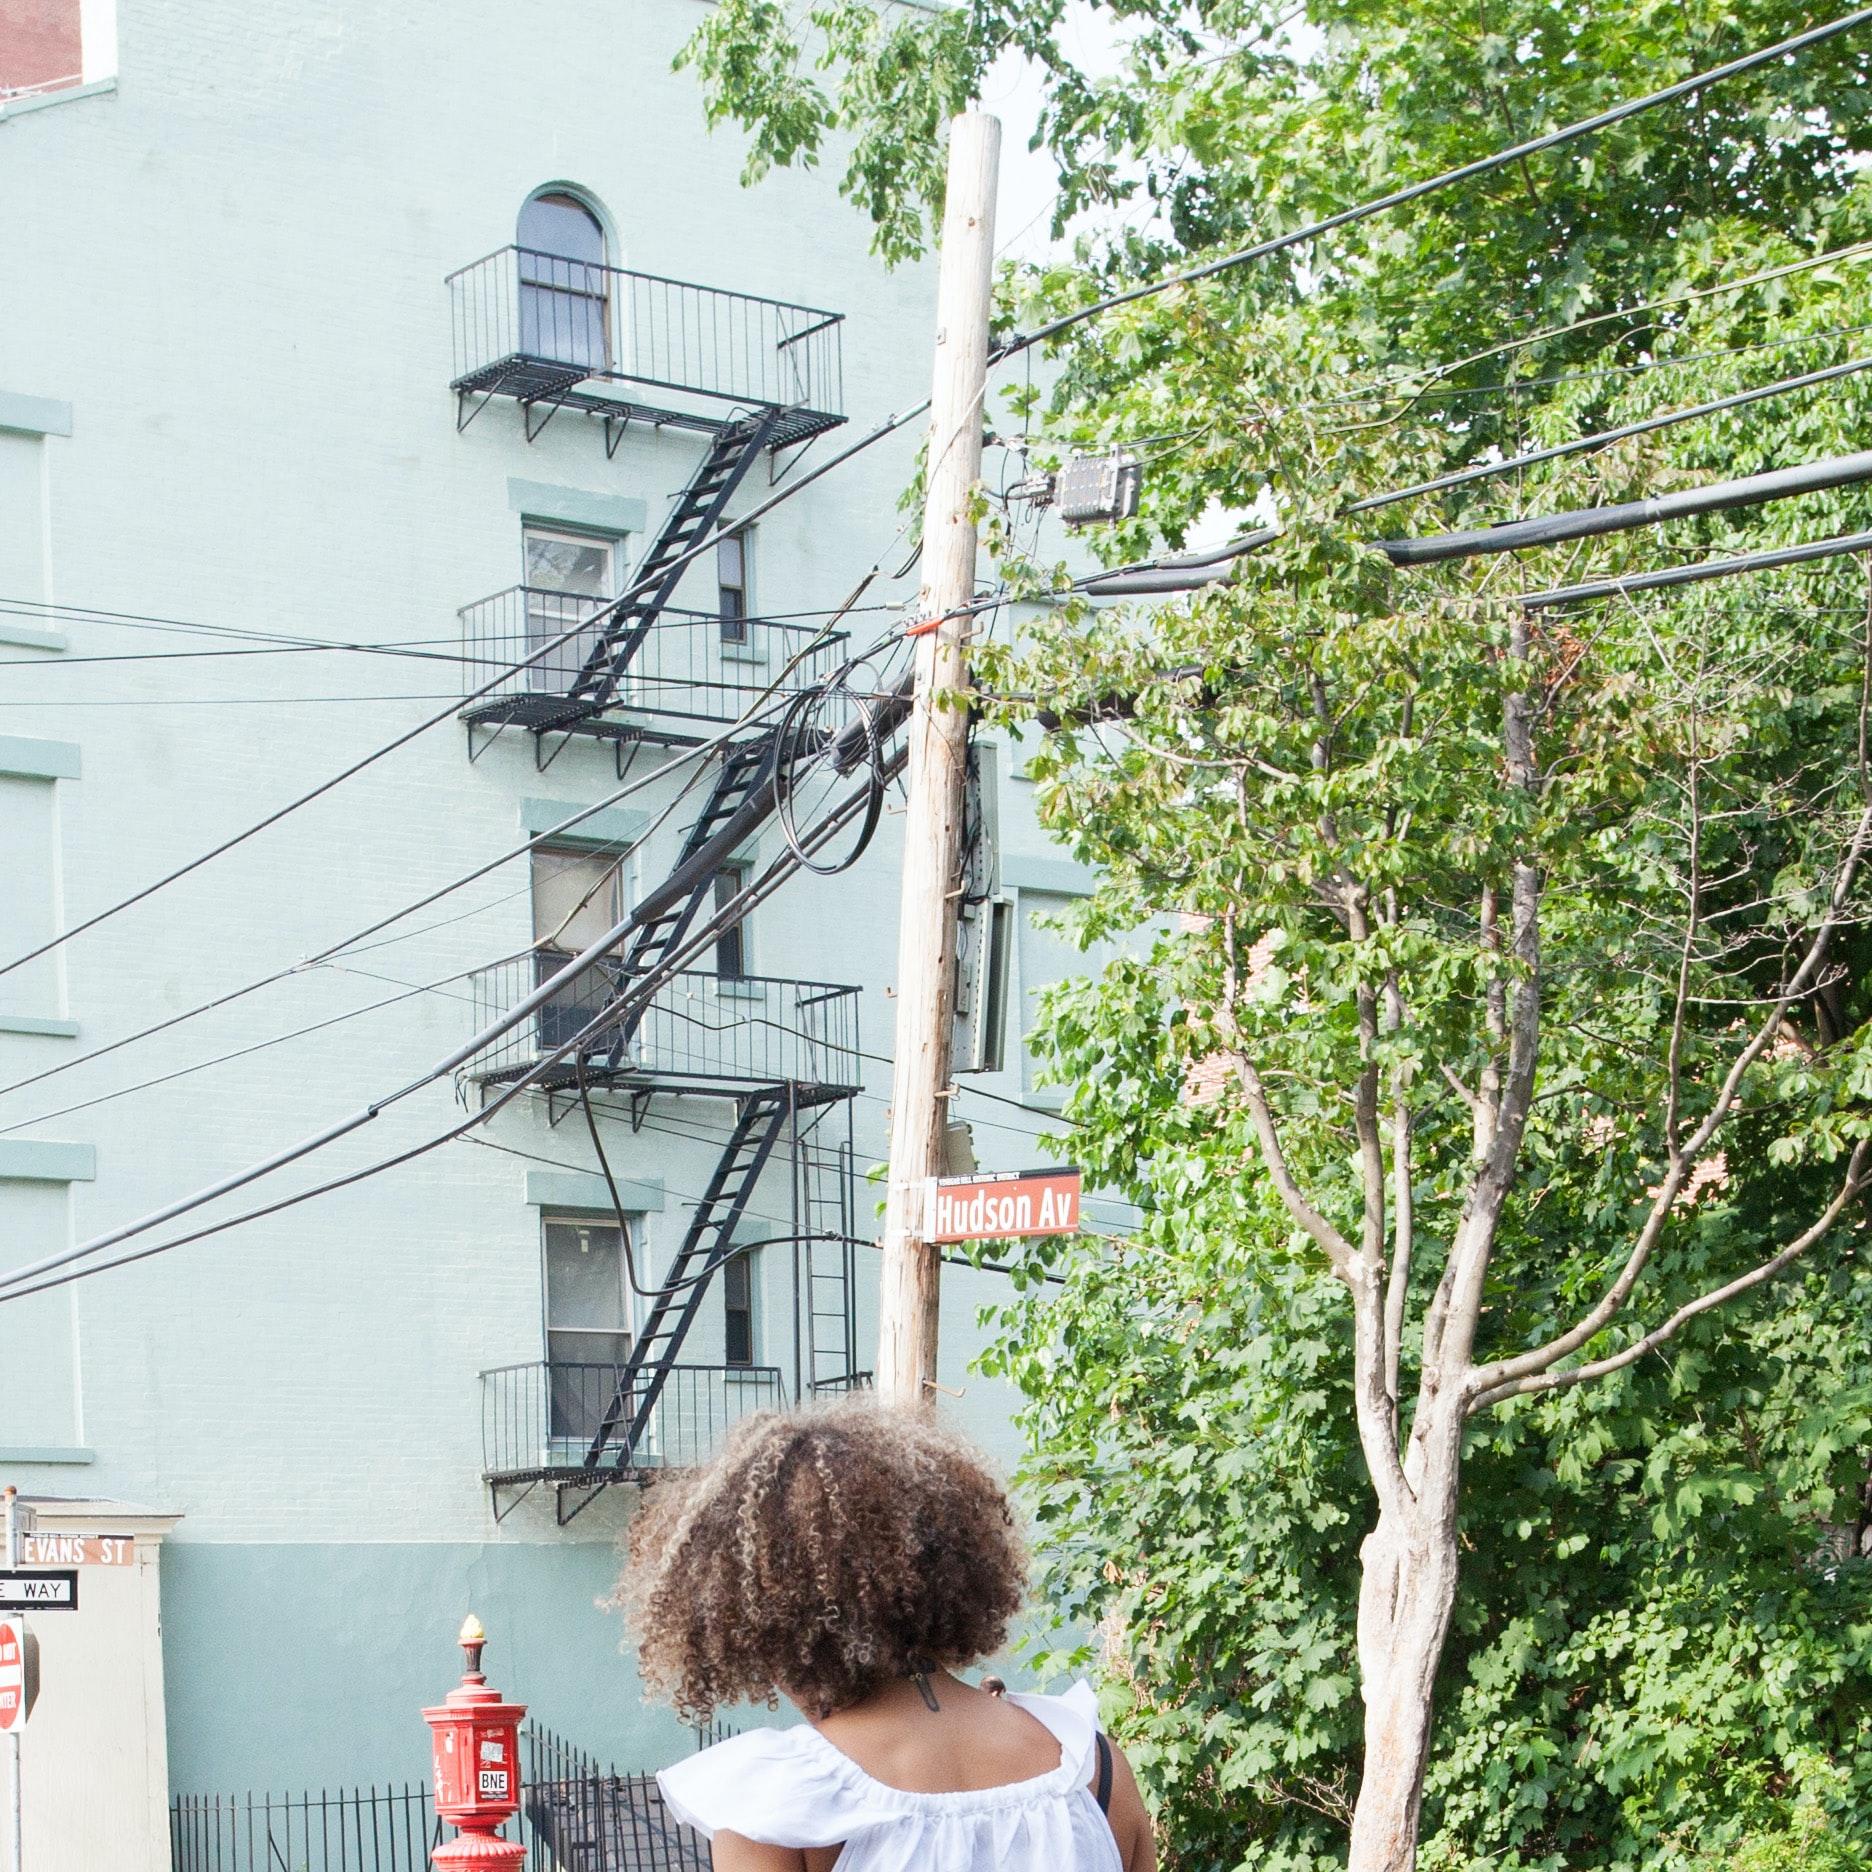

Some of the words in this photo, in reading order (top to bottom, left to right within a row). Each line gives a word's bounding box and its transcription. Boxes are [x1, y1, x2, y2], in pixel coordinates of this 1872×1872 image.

[937, 1189, 1031, 1235] Hudson
[1038, 1187, 1072, 1229] Av
[24, 1537, 85, 1563] EVANS
[100, 1538, 126, 1564] ST
[24, 1582, 61, 1599] WAY
[2, 1642, 17, 1661] NOT
[481, 1773, 505, 1790] BNE
